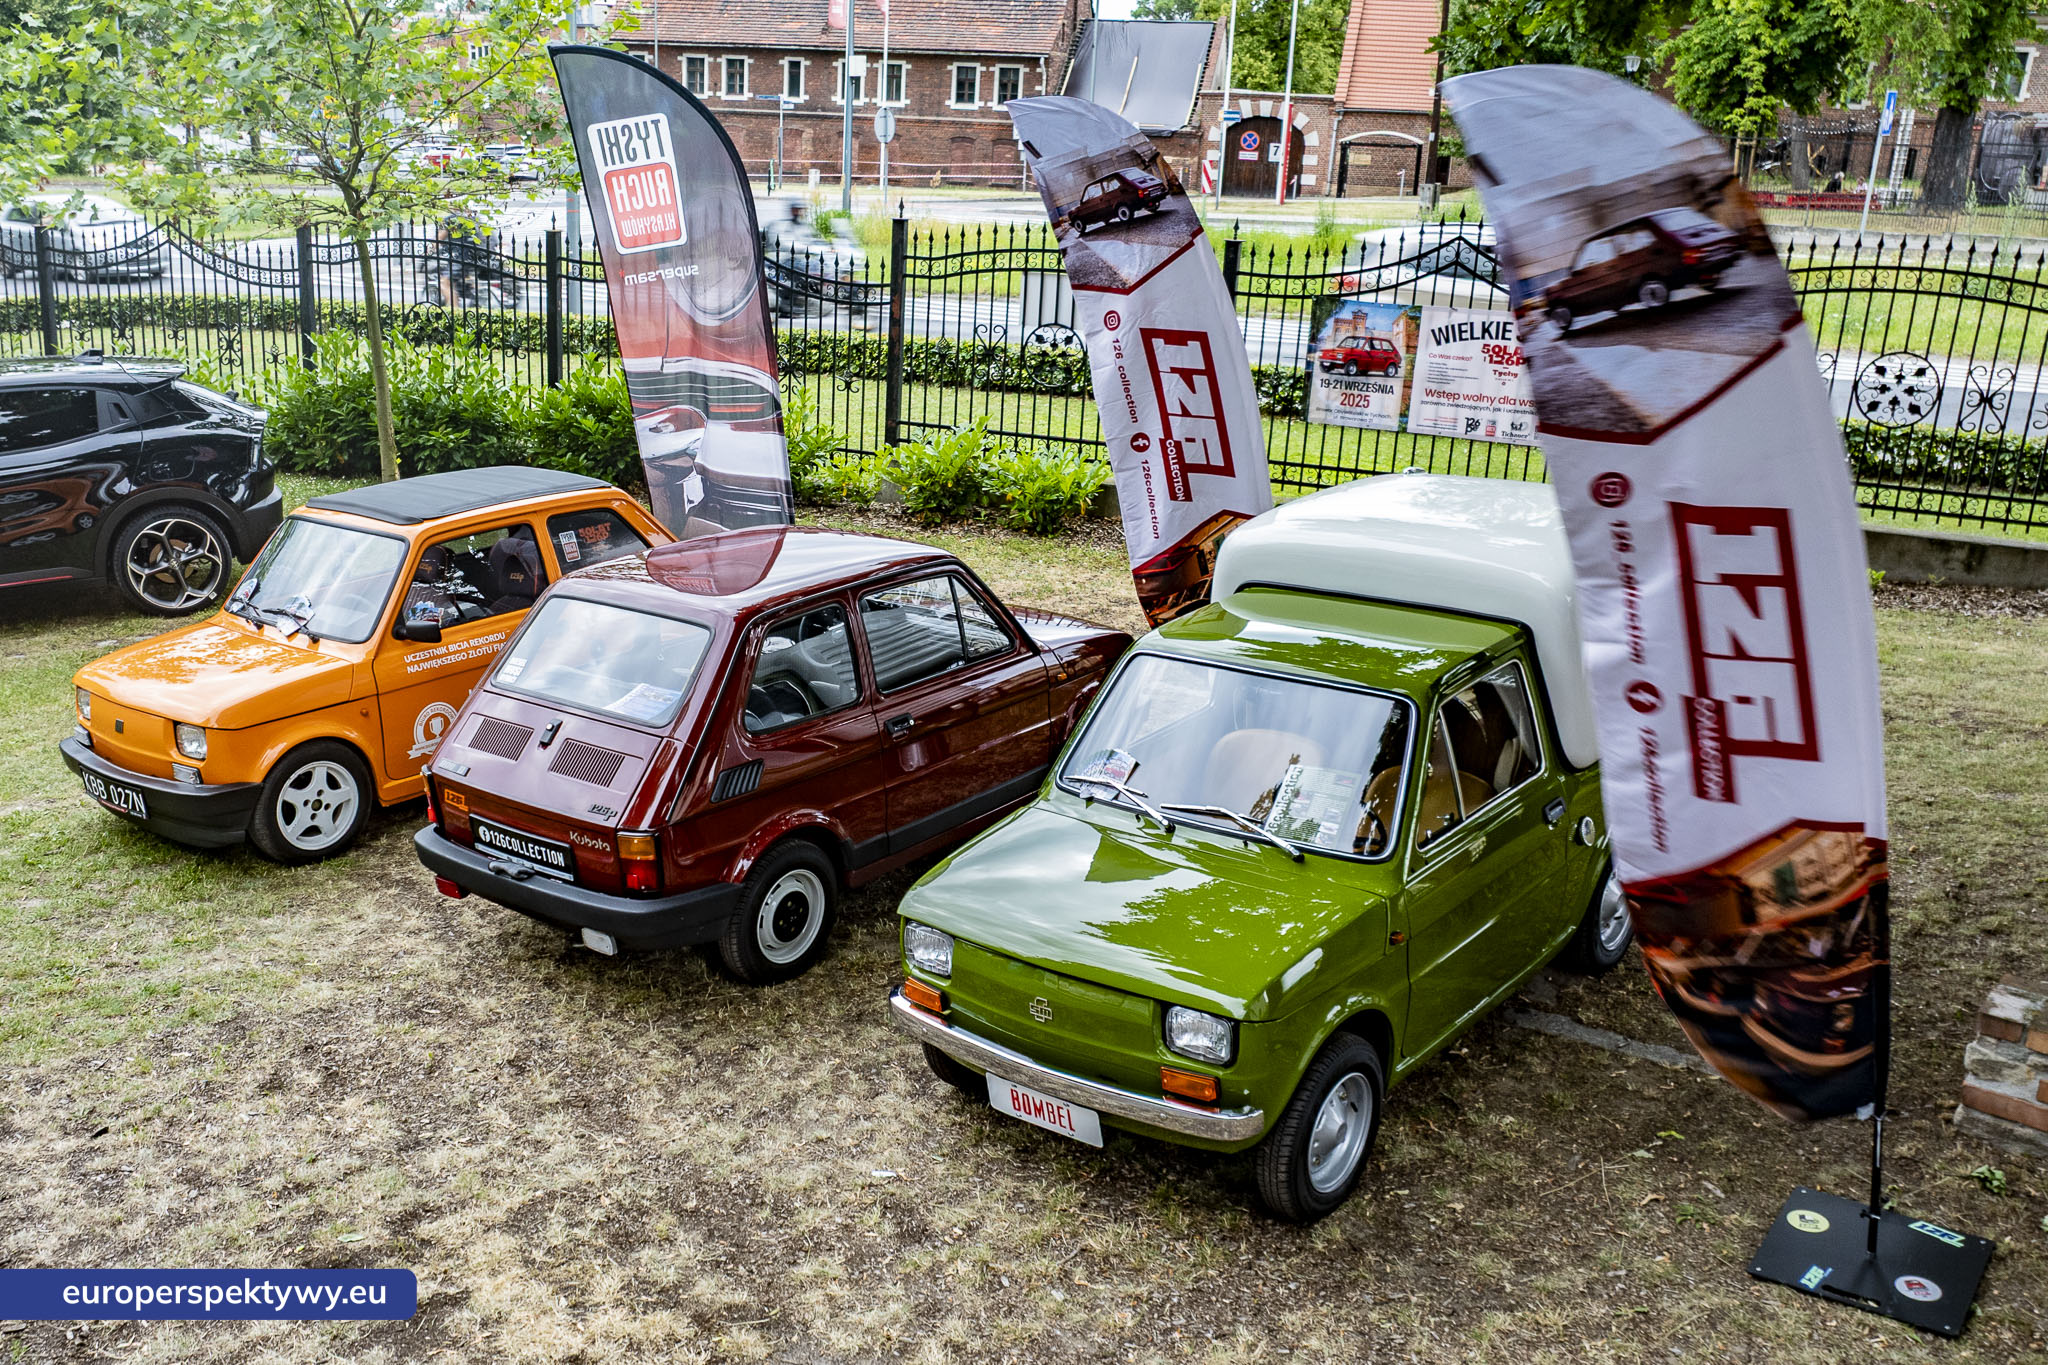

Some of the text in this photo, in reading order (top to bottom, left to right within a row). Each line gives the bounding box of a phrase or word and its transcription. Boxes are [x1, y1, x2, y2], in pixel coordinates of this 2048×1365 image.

[1273, 145, 1280, 156] 7
[1430, 321, 1514, 347] WIELKIE
[1320, 378, 1394, 395] 19-21 WRZEŚNIA
[1492, 369, 1519, 378] Tychy
[1151, 337, 1225, 467] 126
[1340, 392, 1371, 408] 2025
[1425, 388, 1460, 402] Wstęp
[1462, 393, 1496, 406] wolny
[1498, 395, 1517, 405] dla
[1166, 439, 1185, 501] COLLECTION
[1141, 459, 1160, 539] 126collection
[404, 632, 506, 663] UCZESTNIK BICIA REKORDU
[1685, 522, 1806, 745] 126
[407, 652, 468, 674] NAJWIĘKSZEGO
[82, 771, 146, 814] KBB 027N
[490, 830, 565, 868] 126COLLECTION
[569, 831, 611, 852] Kubota
[1010, 1088, 1076, 1132] BOMBEL
